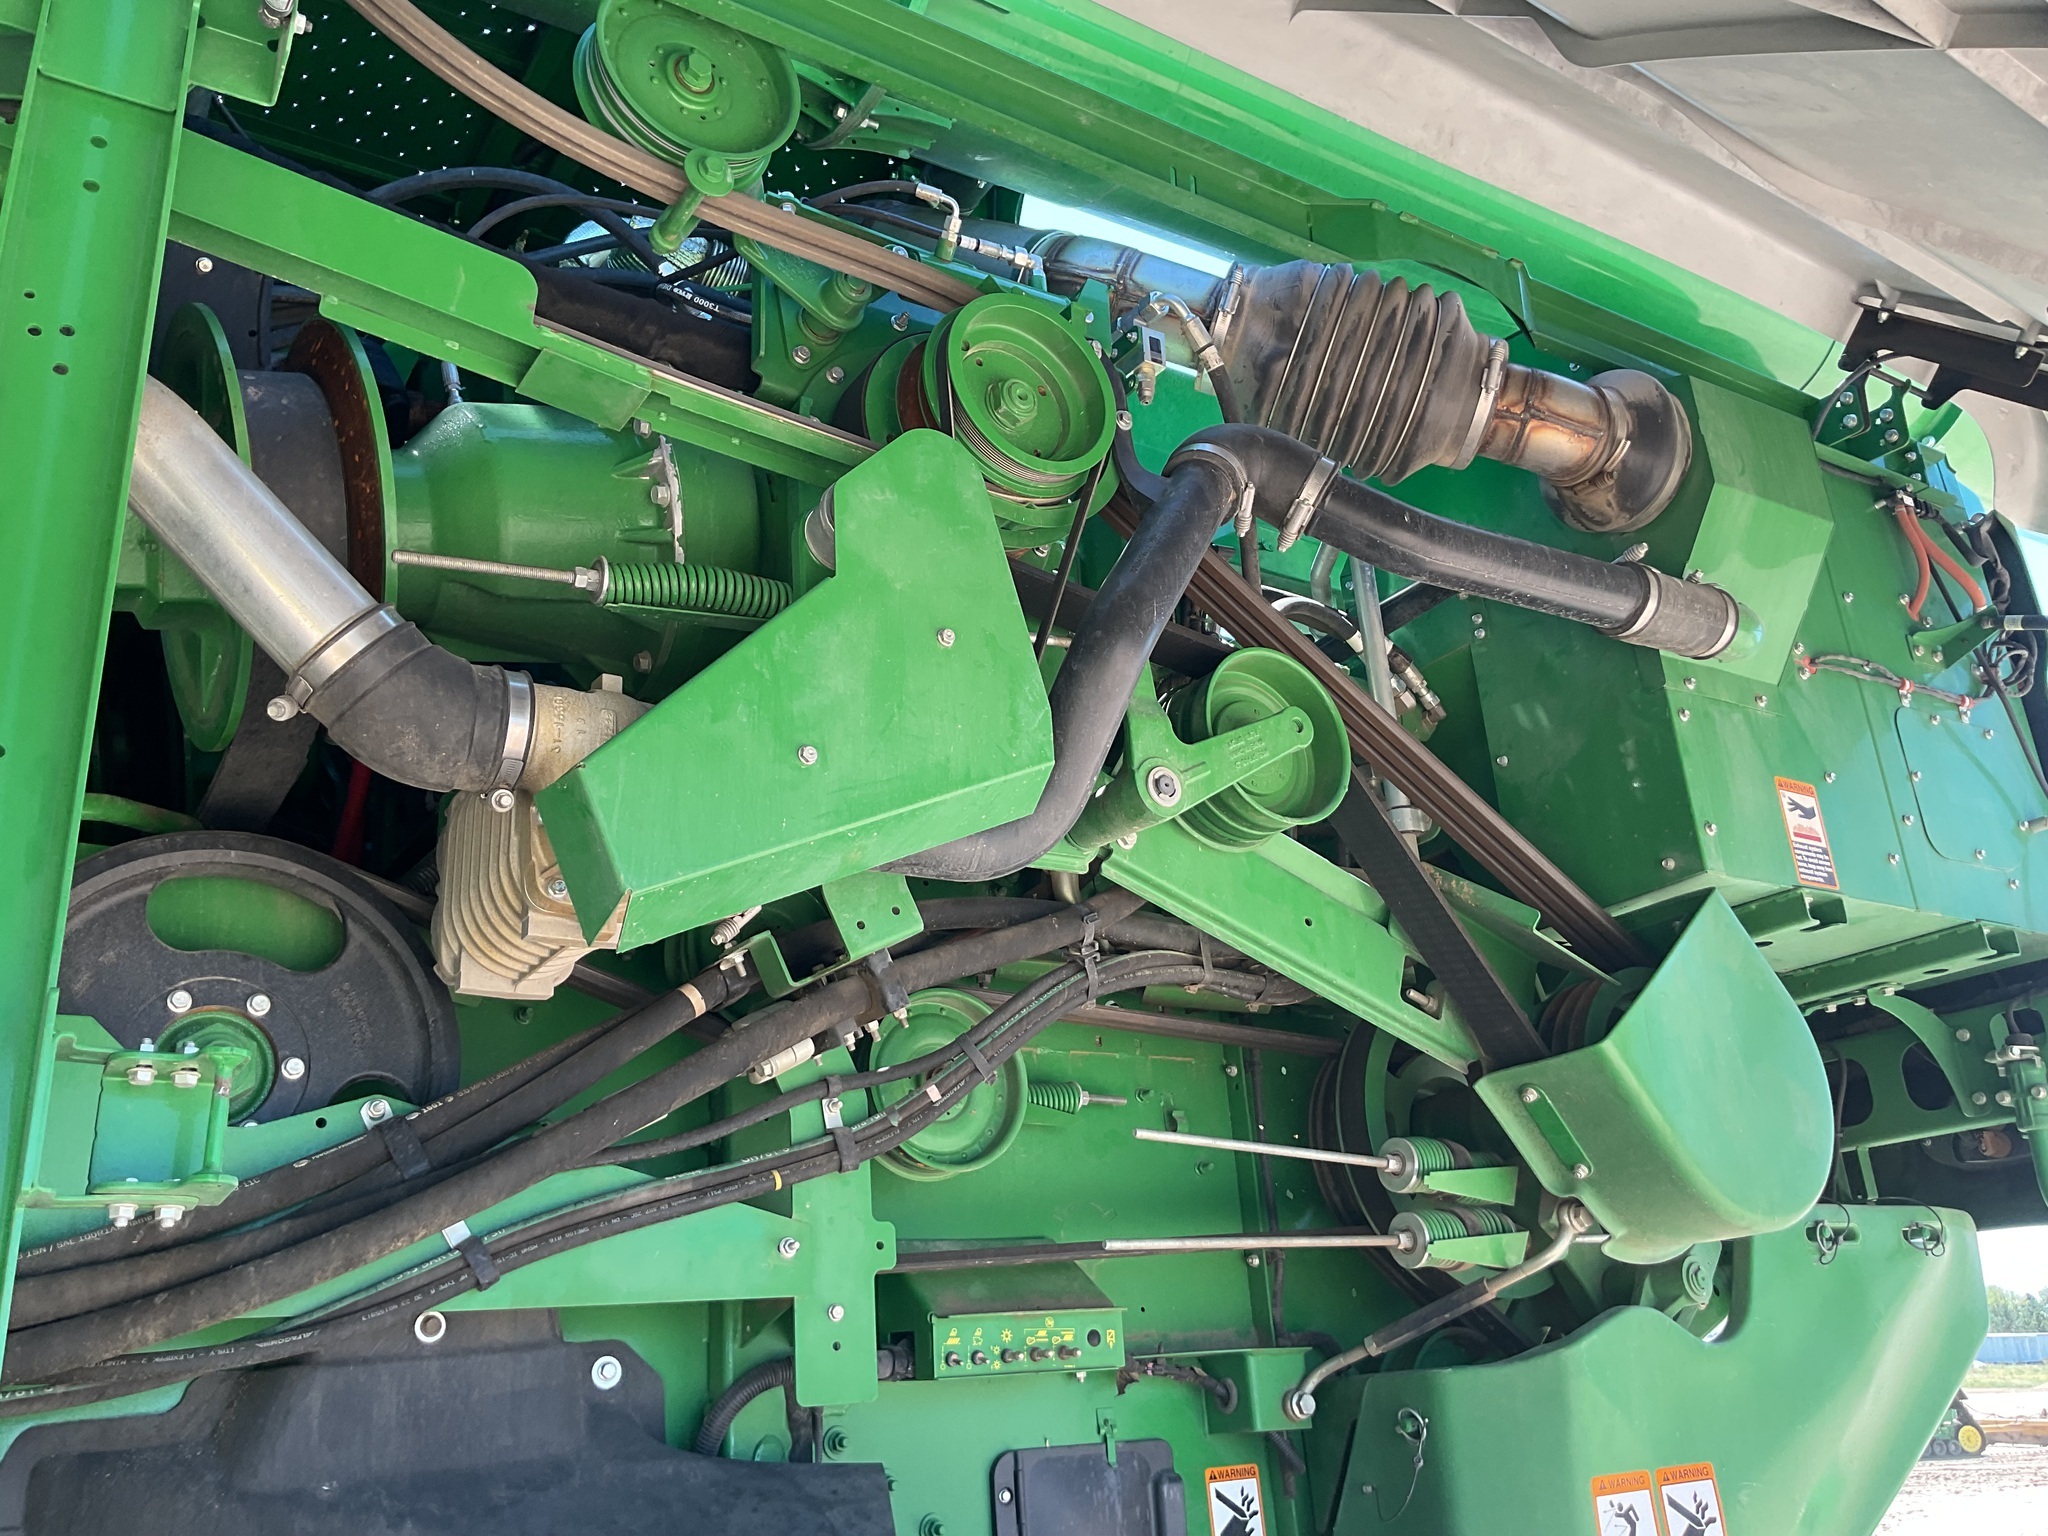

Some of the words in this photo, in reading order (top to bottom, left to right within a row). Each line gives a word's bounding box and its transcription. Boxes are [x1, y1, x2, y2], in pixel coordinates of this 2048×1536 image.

[693, 296, 720, 313] T3000
[1784, 780, 1814, 795] WARNING
[438, 1280, 456, 1291] TYPE
[255, 1329, 321, 1348] ALFAGOMMA
[208, 1347, 235, 1357] ITALY
[1216, 1466, 1256, 1480] WARNING
[1669, 1466, 1709, 1480] WARNING
[1607, 1475, 1645, 1489] WARNING
